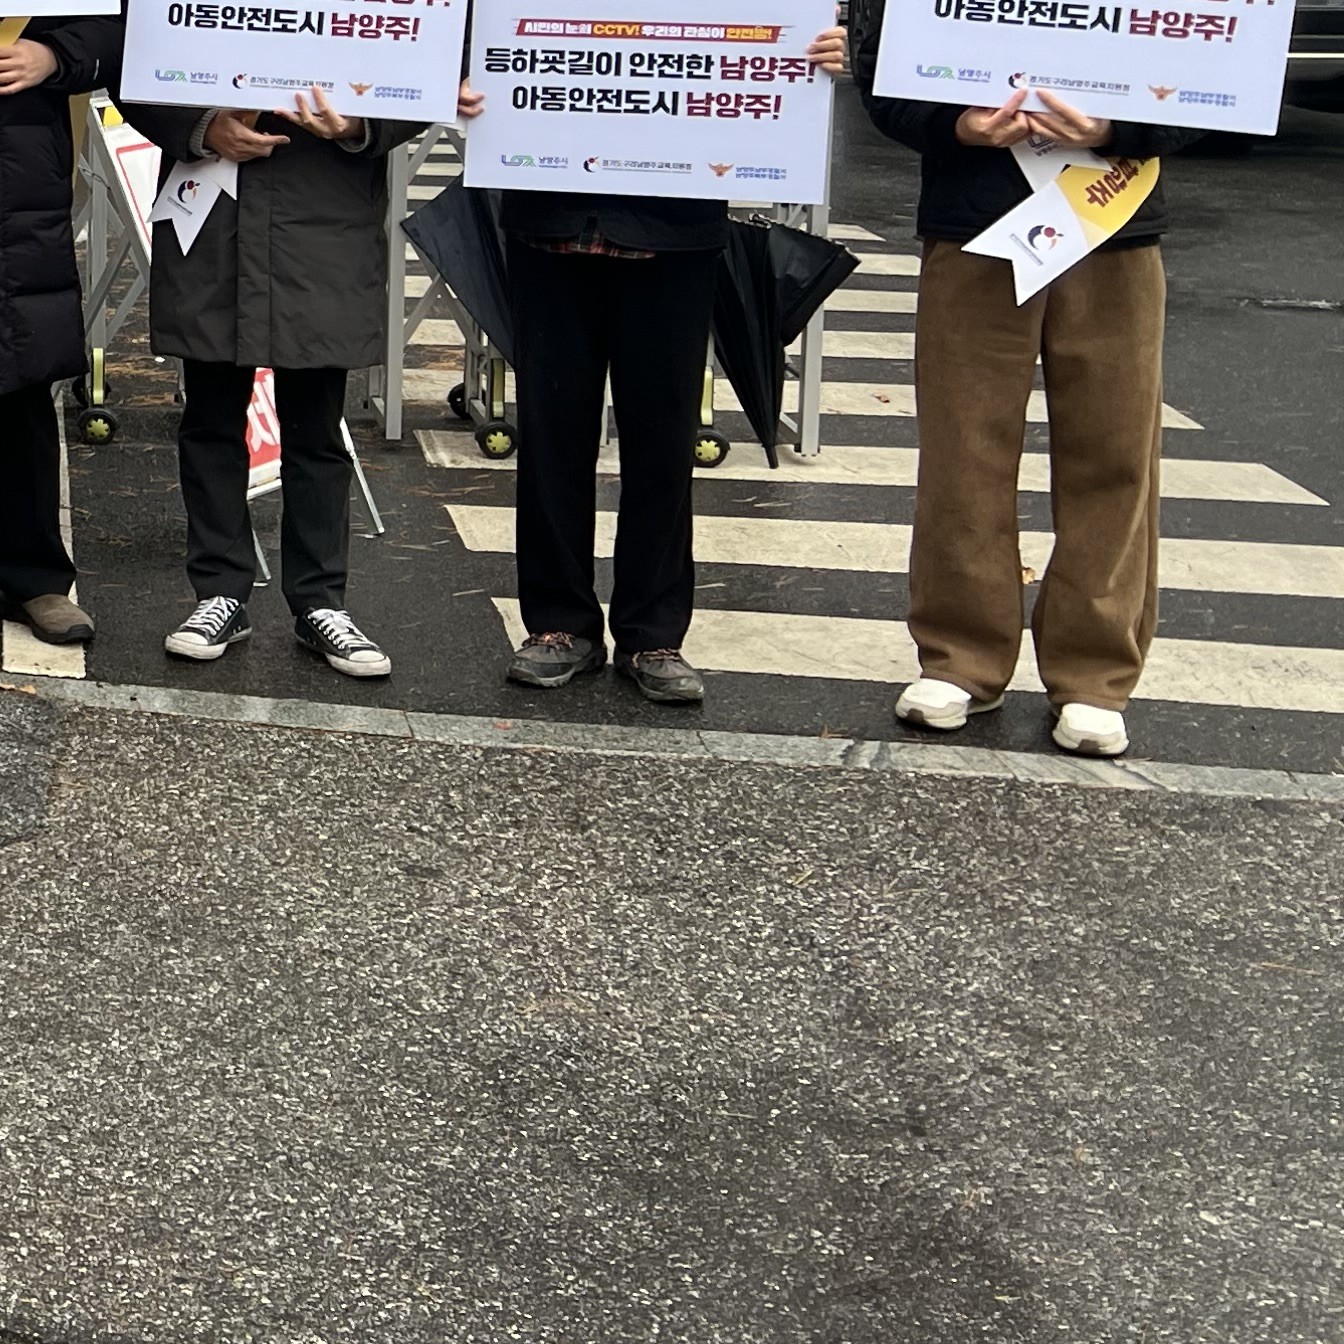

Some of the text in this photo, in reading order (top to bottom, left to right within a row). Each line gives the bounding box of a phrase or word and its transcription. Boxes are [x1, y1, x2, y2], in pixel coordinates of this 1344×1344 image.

[167, 2, 420, 41] 아동안전도시 남양주!
[593, 23, 639, 36] CCTV!
[1127, 8, 1237, 42] 남양주!
[484, 47, 816, 83] 등하굣길이 안전한 남양주!
[512, 84, 781, 119] 아동안전도시 남양주!
